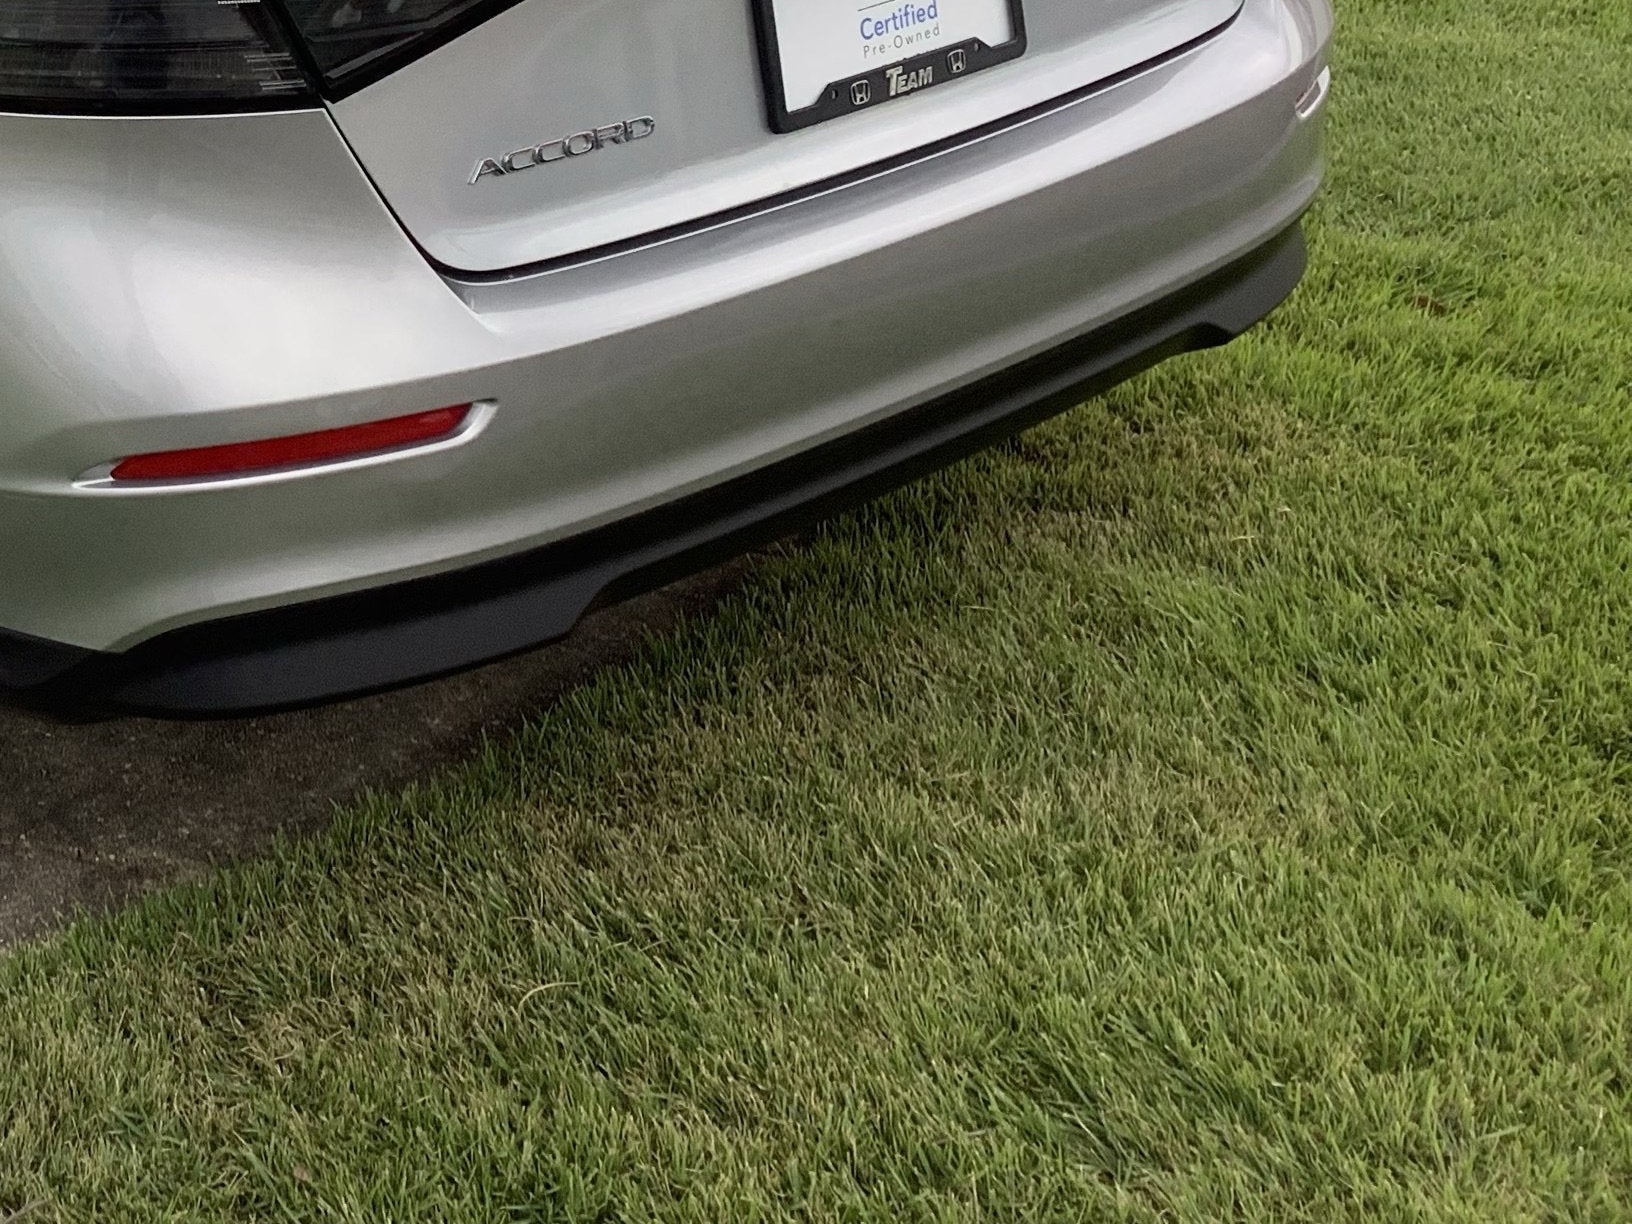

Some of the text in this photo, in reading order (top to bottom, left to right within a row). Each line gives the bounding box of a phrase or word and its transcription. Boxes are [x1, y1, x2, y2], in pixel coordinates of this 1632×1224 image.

[863, 22, 941, 59] Pre-Owned
[885, 65, 933, 97] TEAM
[468, 115, 655, 185] ACCORD
